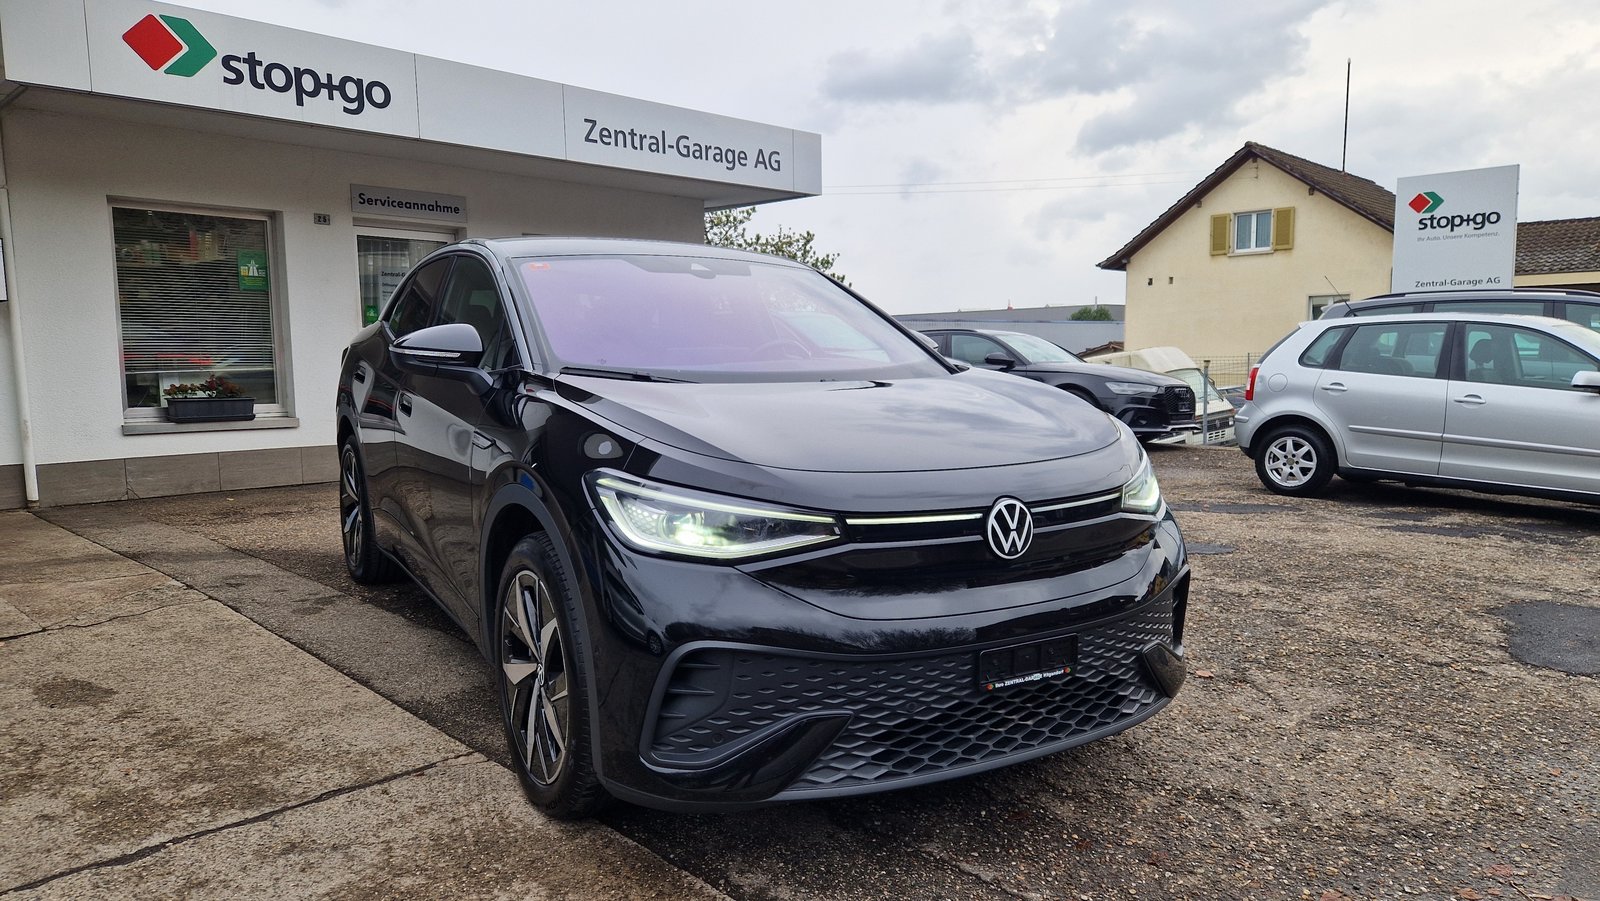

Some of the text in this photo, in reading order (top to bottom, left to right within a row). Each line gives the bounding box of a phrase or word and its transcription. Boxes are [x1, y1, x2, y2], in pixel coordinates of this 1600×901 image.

[221, 52, 391, 115] stop+go
[583, 118, 781, 171] Zentral-Garage AG
[358, 192, 460, 214] Serviceannahme
[1418, 211, 1501, 232] stop+go
[1415, 276, 1501, 288] Zentral-Garage AG
